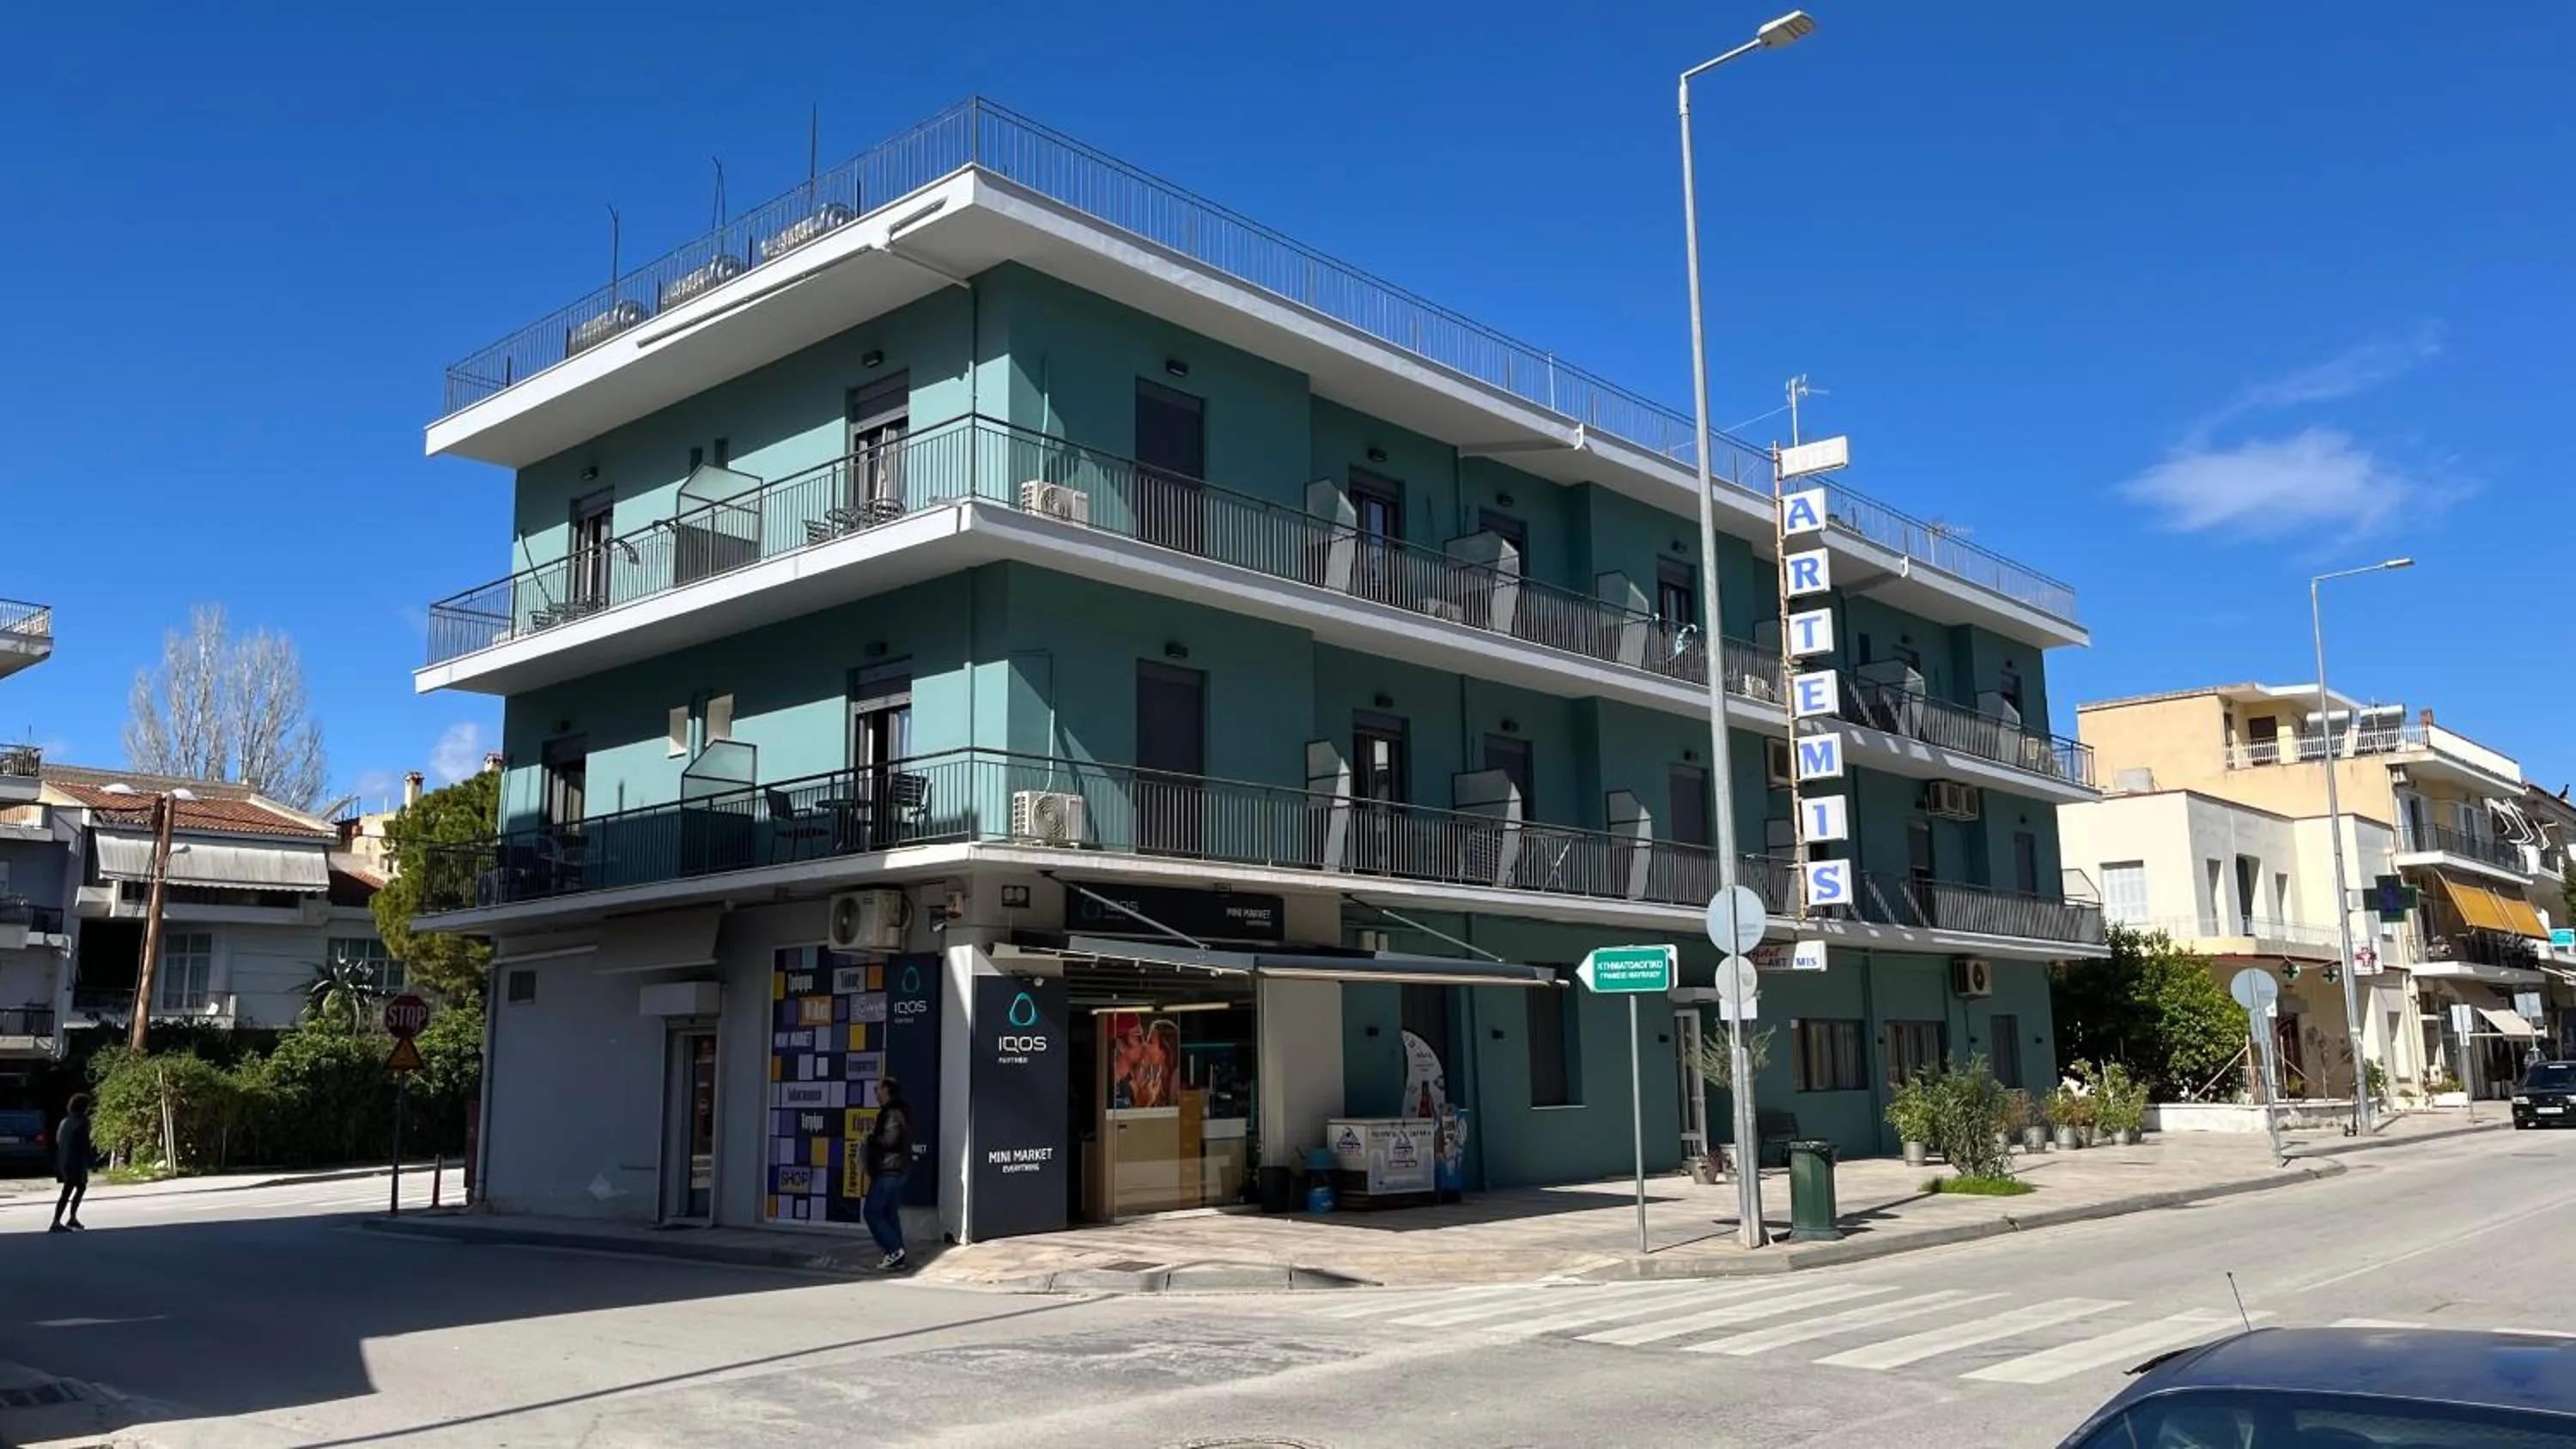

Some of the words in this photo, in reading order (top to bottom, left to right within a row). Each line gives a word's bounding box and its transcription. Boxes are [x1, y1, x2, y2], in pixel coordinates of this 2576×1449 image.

[894, 1000, 927, 1015] IQOS
[388, 1004, 427, 1030] STOP
[999, 1036, 1048, 1053] IQOS
[988, 1149, 1012, 1164] MINI
[1013, 1147, 1054, 1162] MARKET
